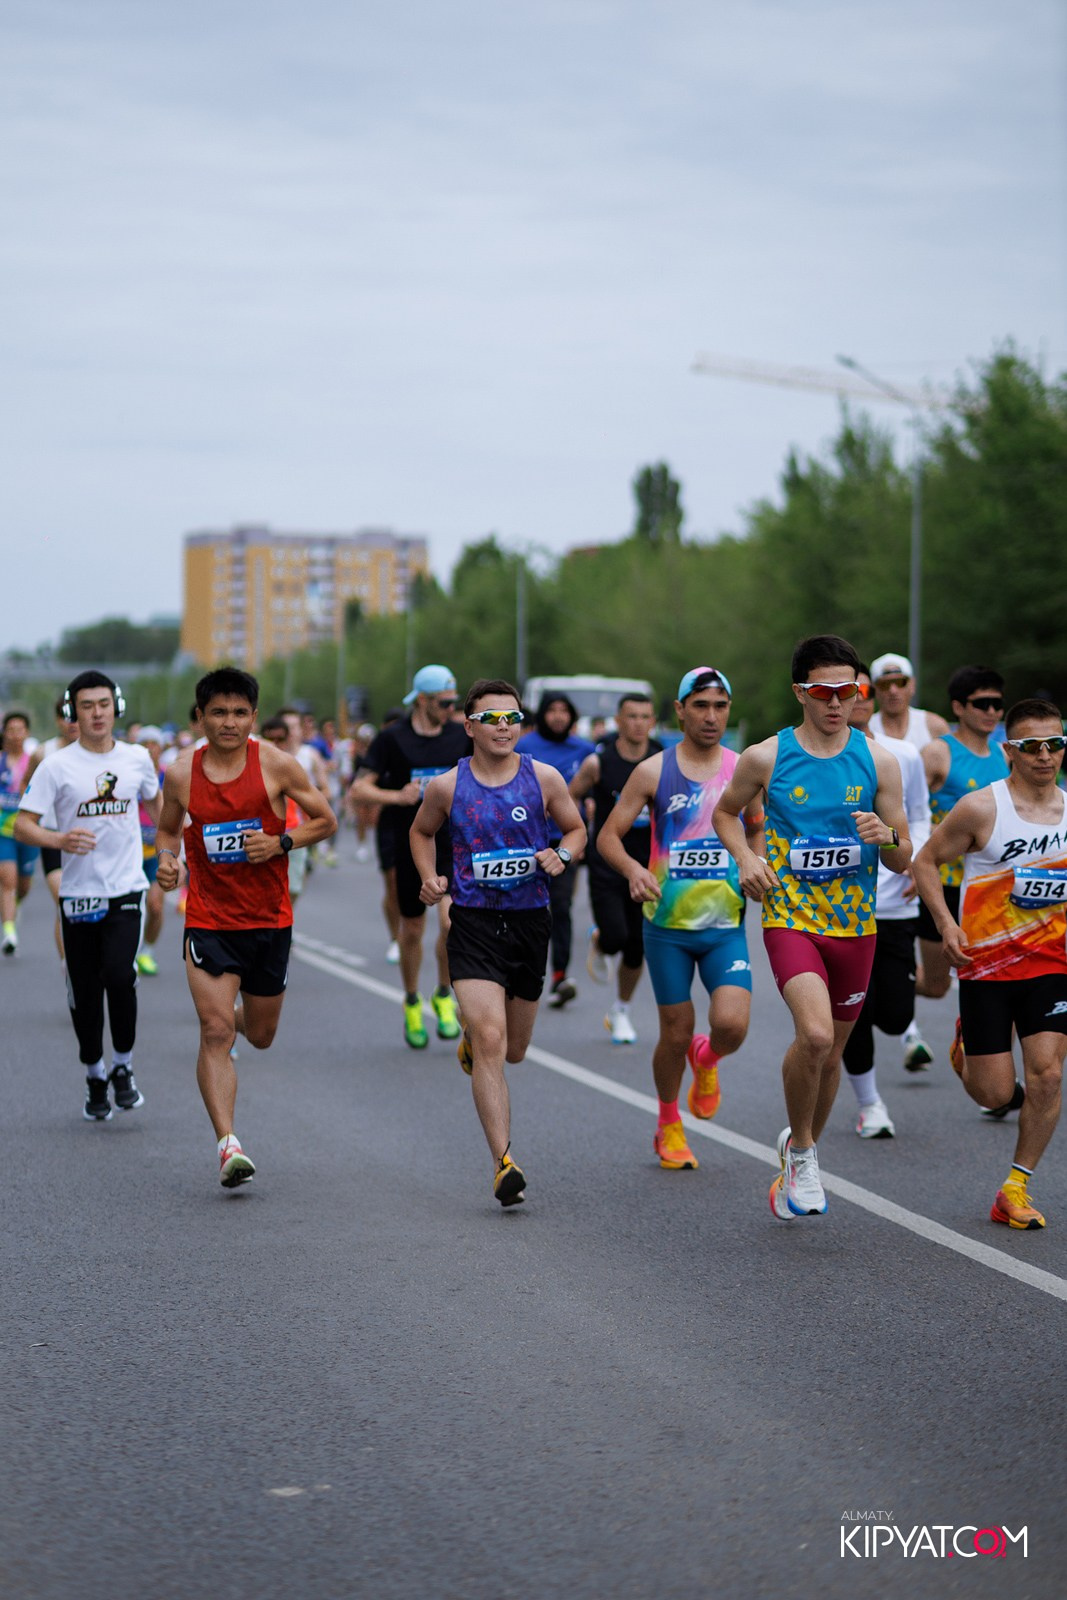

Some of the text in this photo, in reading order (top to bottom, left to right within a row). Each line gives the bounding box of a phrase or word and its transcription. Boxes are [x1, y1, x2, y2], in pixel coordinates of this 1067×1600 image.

[216, 833, 253, 851] 121
[994, 830, 1067, 865] BMA
[678, 851, 721, 866] 1593
[801, 848, 851, 869] 1516
[481, 859, 530, 878] 1459
[1022, 880, 1066, 898] 1514
[70, 897, 101, 913] 1512
